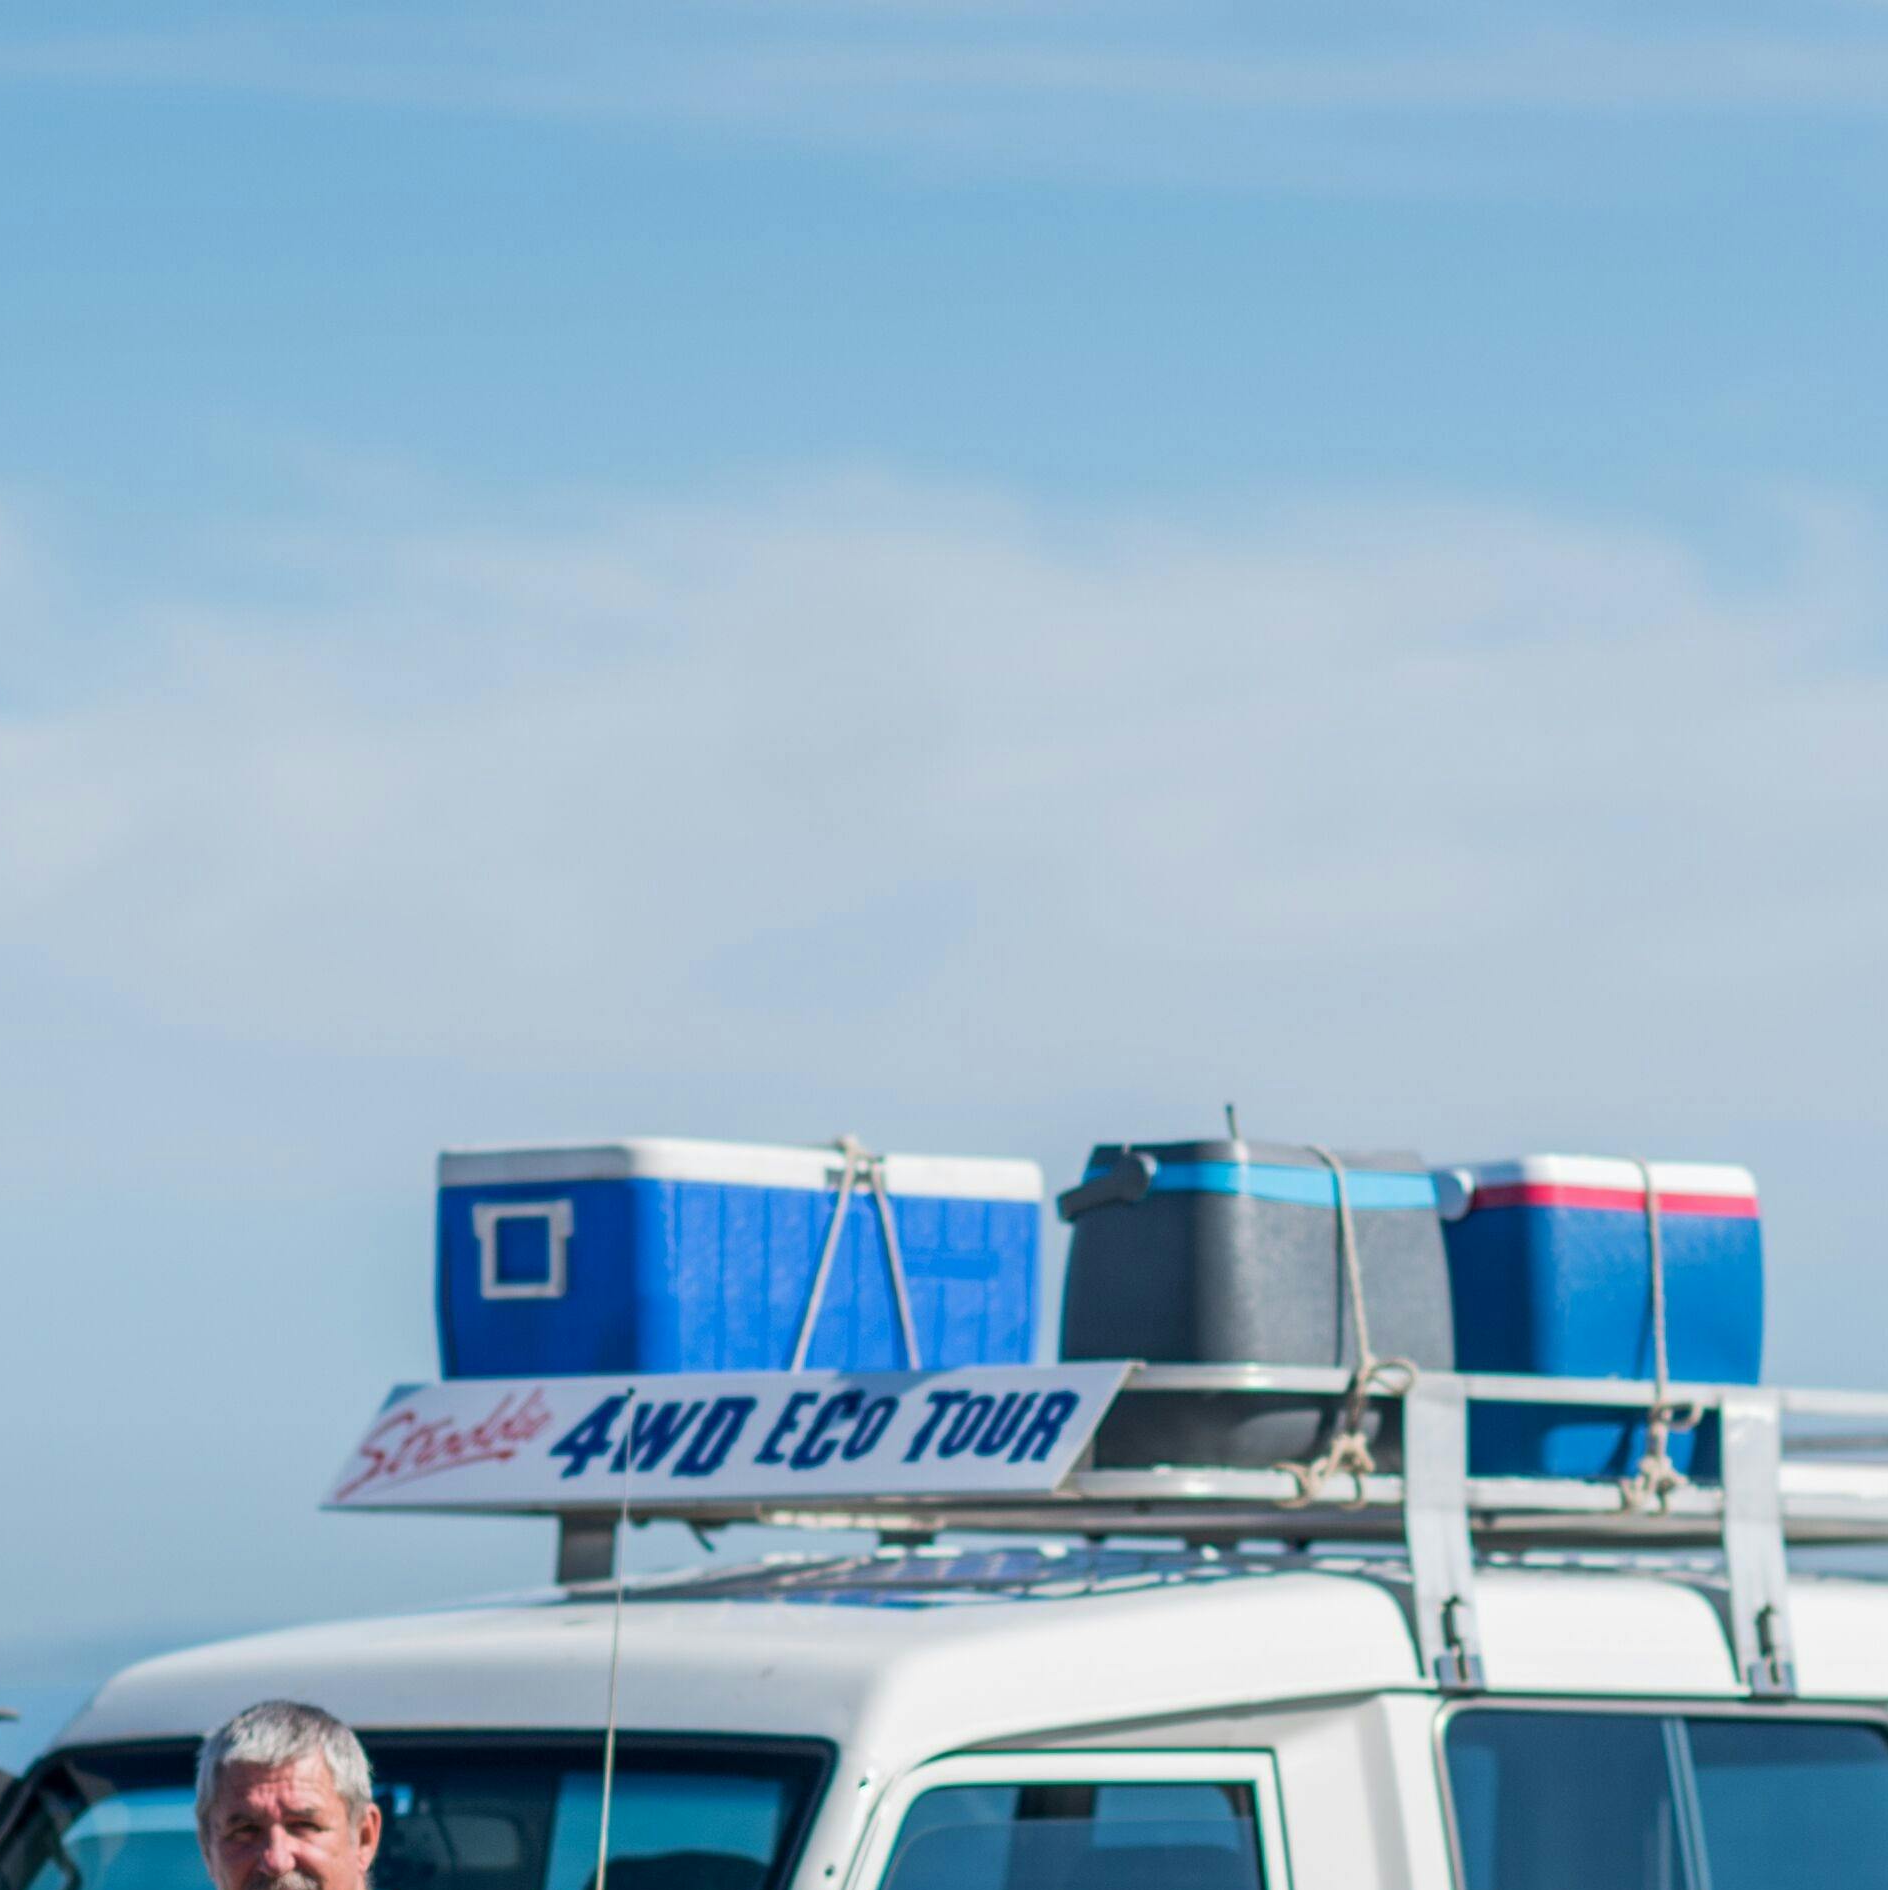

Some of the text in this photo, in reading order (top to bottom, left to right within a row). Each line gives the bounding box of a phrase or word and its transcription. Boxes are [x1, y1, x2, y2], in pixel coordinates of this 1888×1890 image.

[550, 1394, 759, 1480] 4WD
[753, 1388, 900, 1470] ECO
[900, 1386, 1082, 1466] TOUR
